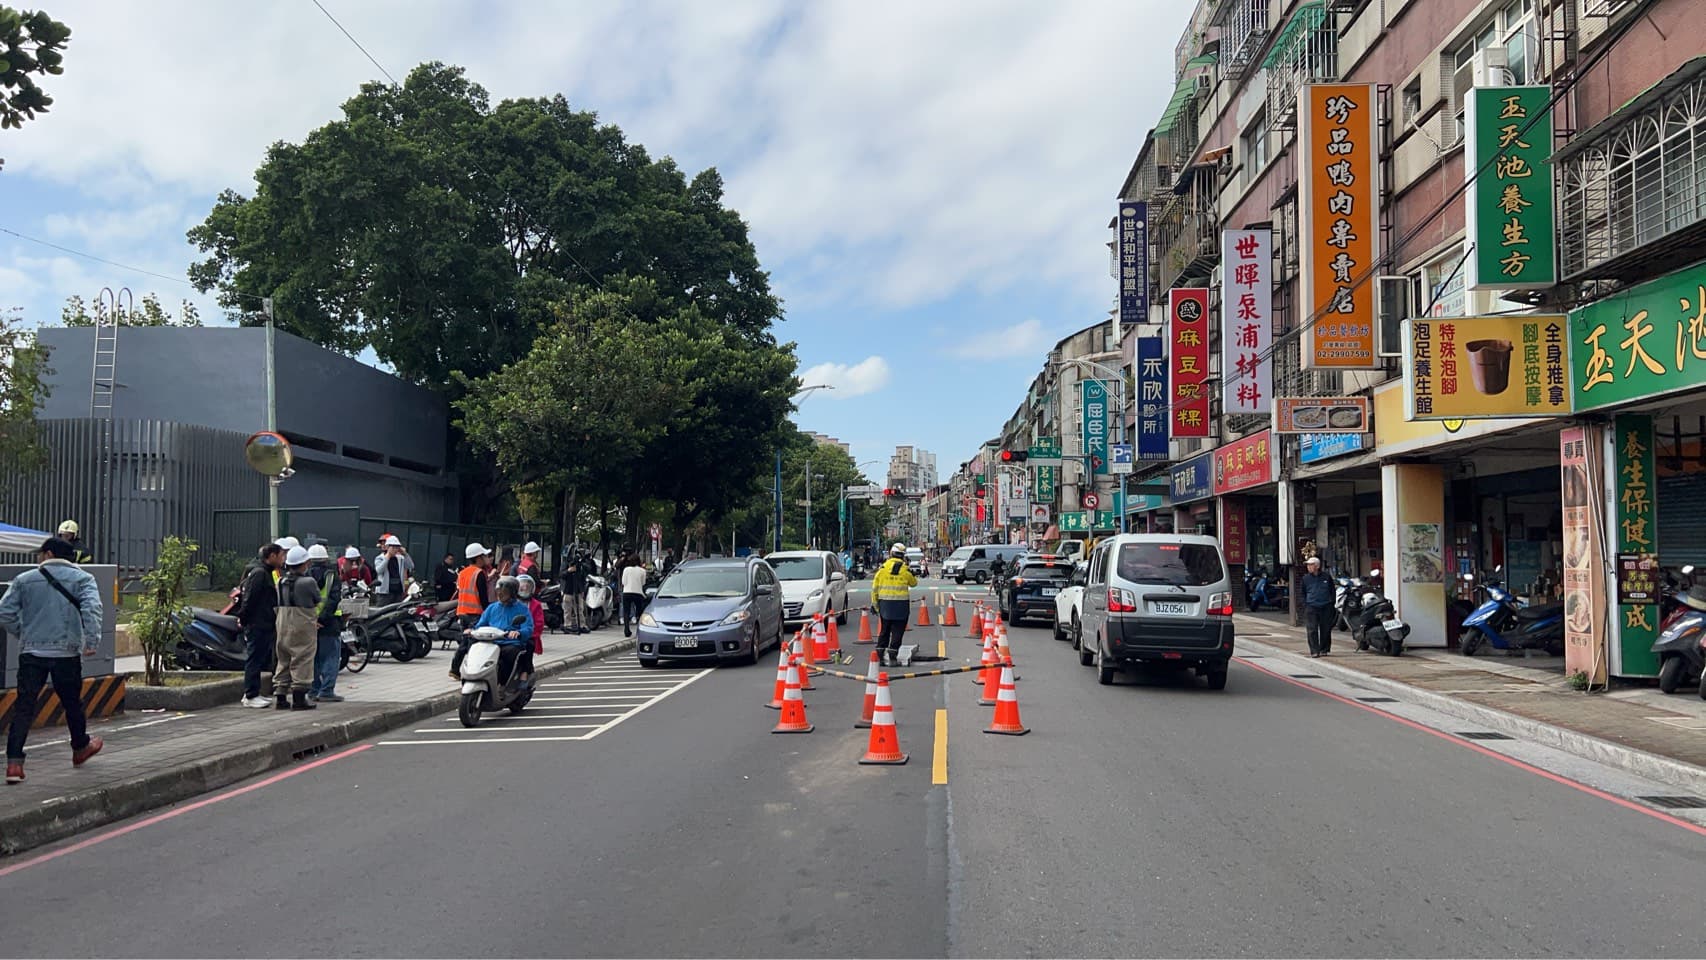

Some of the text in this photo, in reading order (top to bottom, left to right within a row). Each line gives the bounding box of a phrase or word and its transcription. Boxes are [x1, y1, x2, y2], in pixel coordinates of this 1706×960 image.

[1326, 95, 1356, 314] 珍品鴨肉專賣店
[1496, 96, 1532, 276] 玉天池養生方
[1235, 234, 1261, 409] 世暉泉浦材料
[1414, 323, 1432, 414] 泡足養生館
[1439, 323, 1457, 395] 特殊泡腳
[1523, 323, 1541, 406] 腳底按摩
[1545, 322, 1564, 406] 全身推拿
[1582, 284, 1706, 391] 玉天池
[1177, 328, 1202, 427] 麻豆碗粿
[1114, 448, 1123, 462] P
[1622, 430, 1652, 632] 養生保健成
